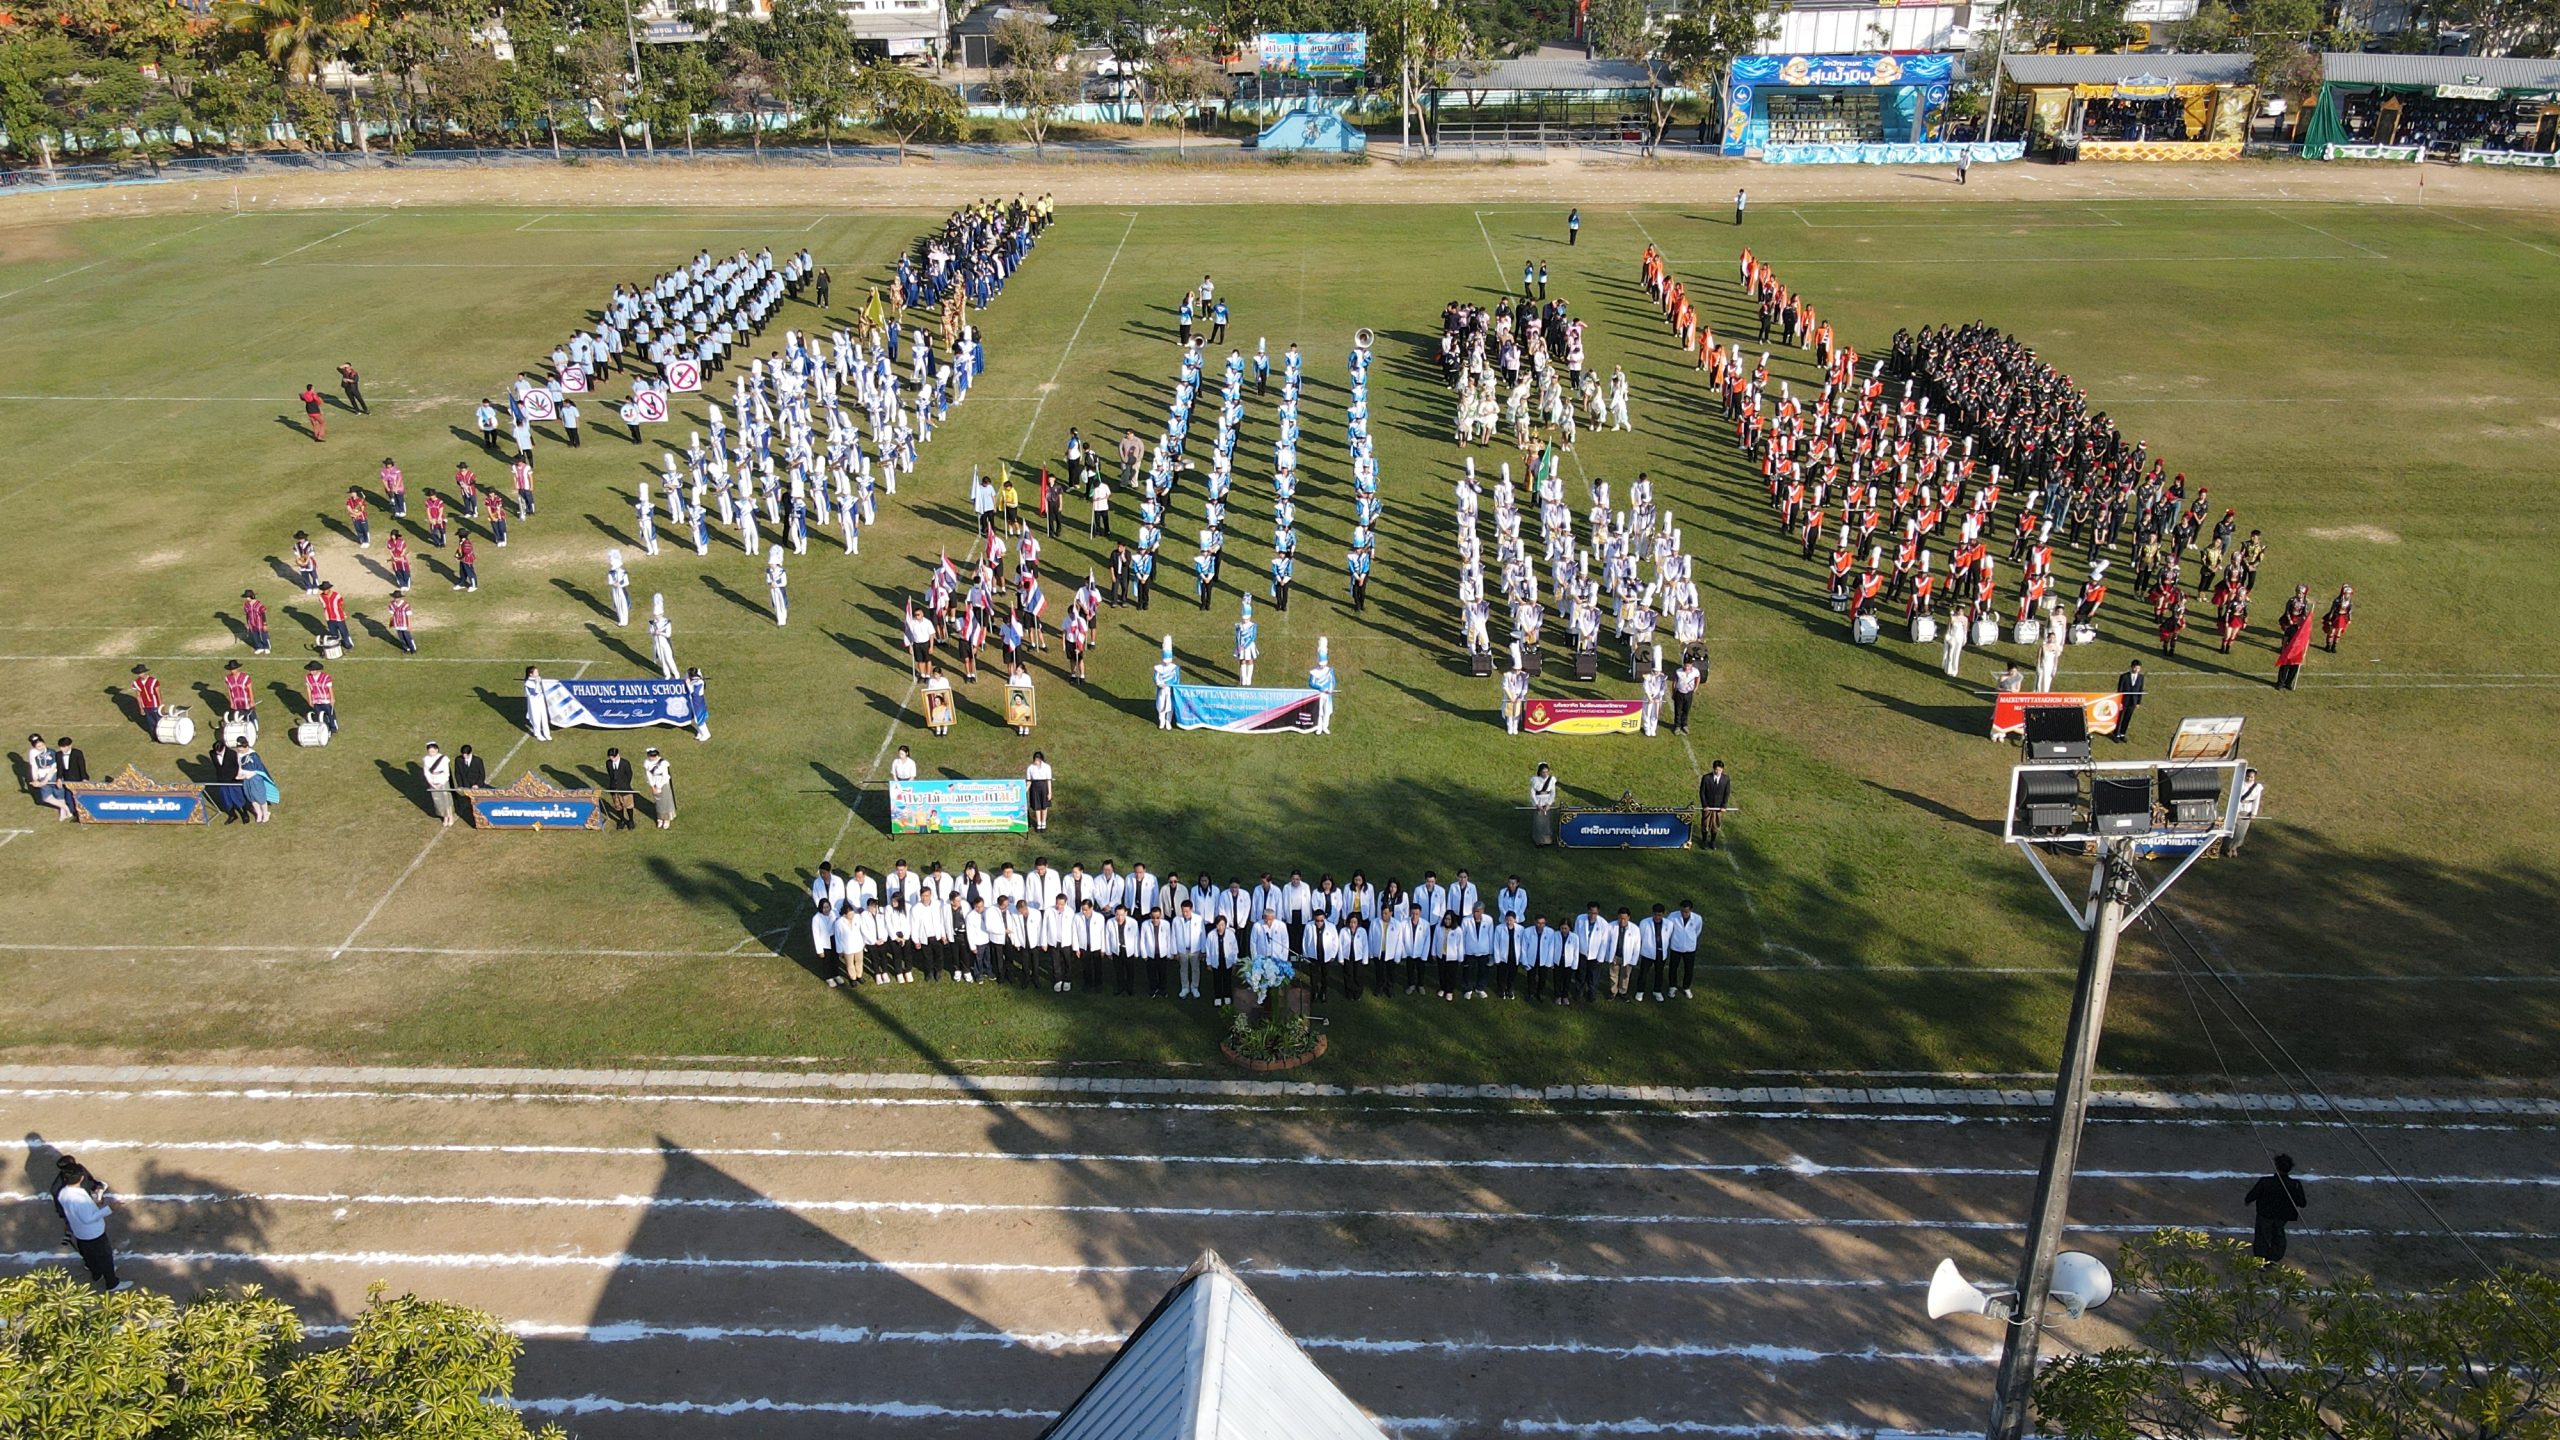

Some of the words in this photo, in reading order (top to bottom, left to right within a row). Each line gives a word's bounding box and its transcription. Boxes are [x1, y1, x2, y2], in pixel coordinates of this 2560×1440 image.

[573, 685, 617, 697] PHADUNG
[620, 684, 650, 696] PANYA
[652, 684, 687, 696] SCHOOL
[1580, 823, 1670, 838] สหวิทยาเขตลุ่มน้ำเมย
